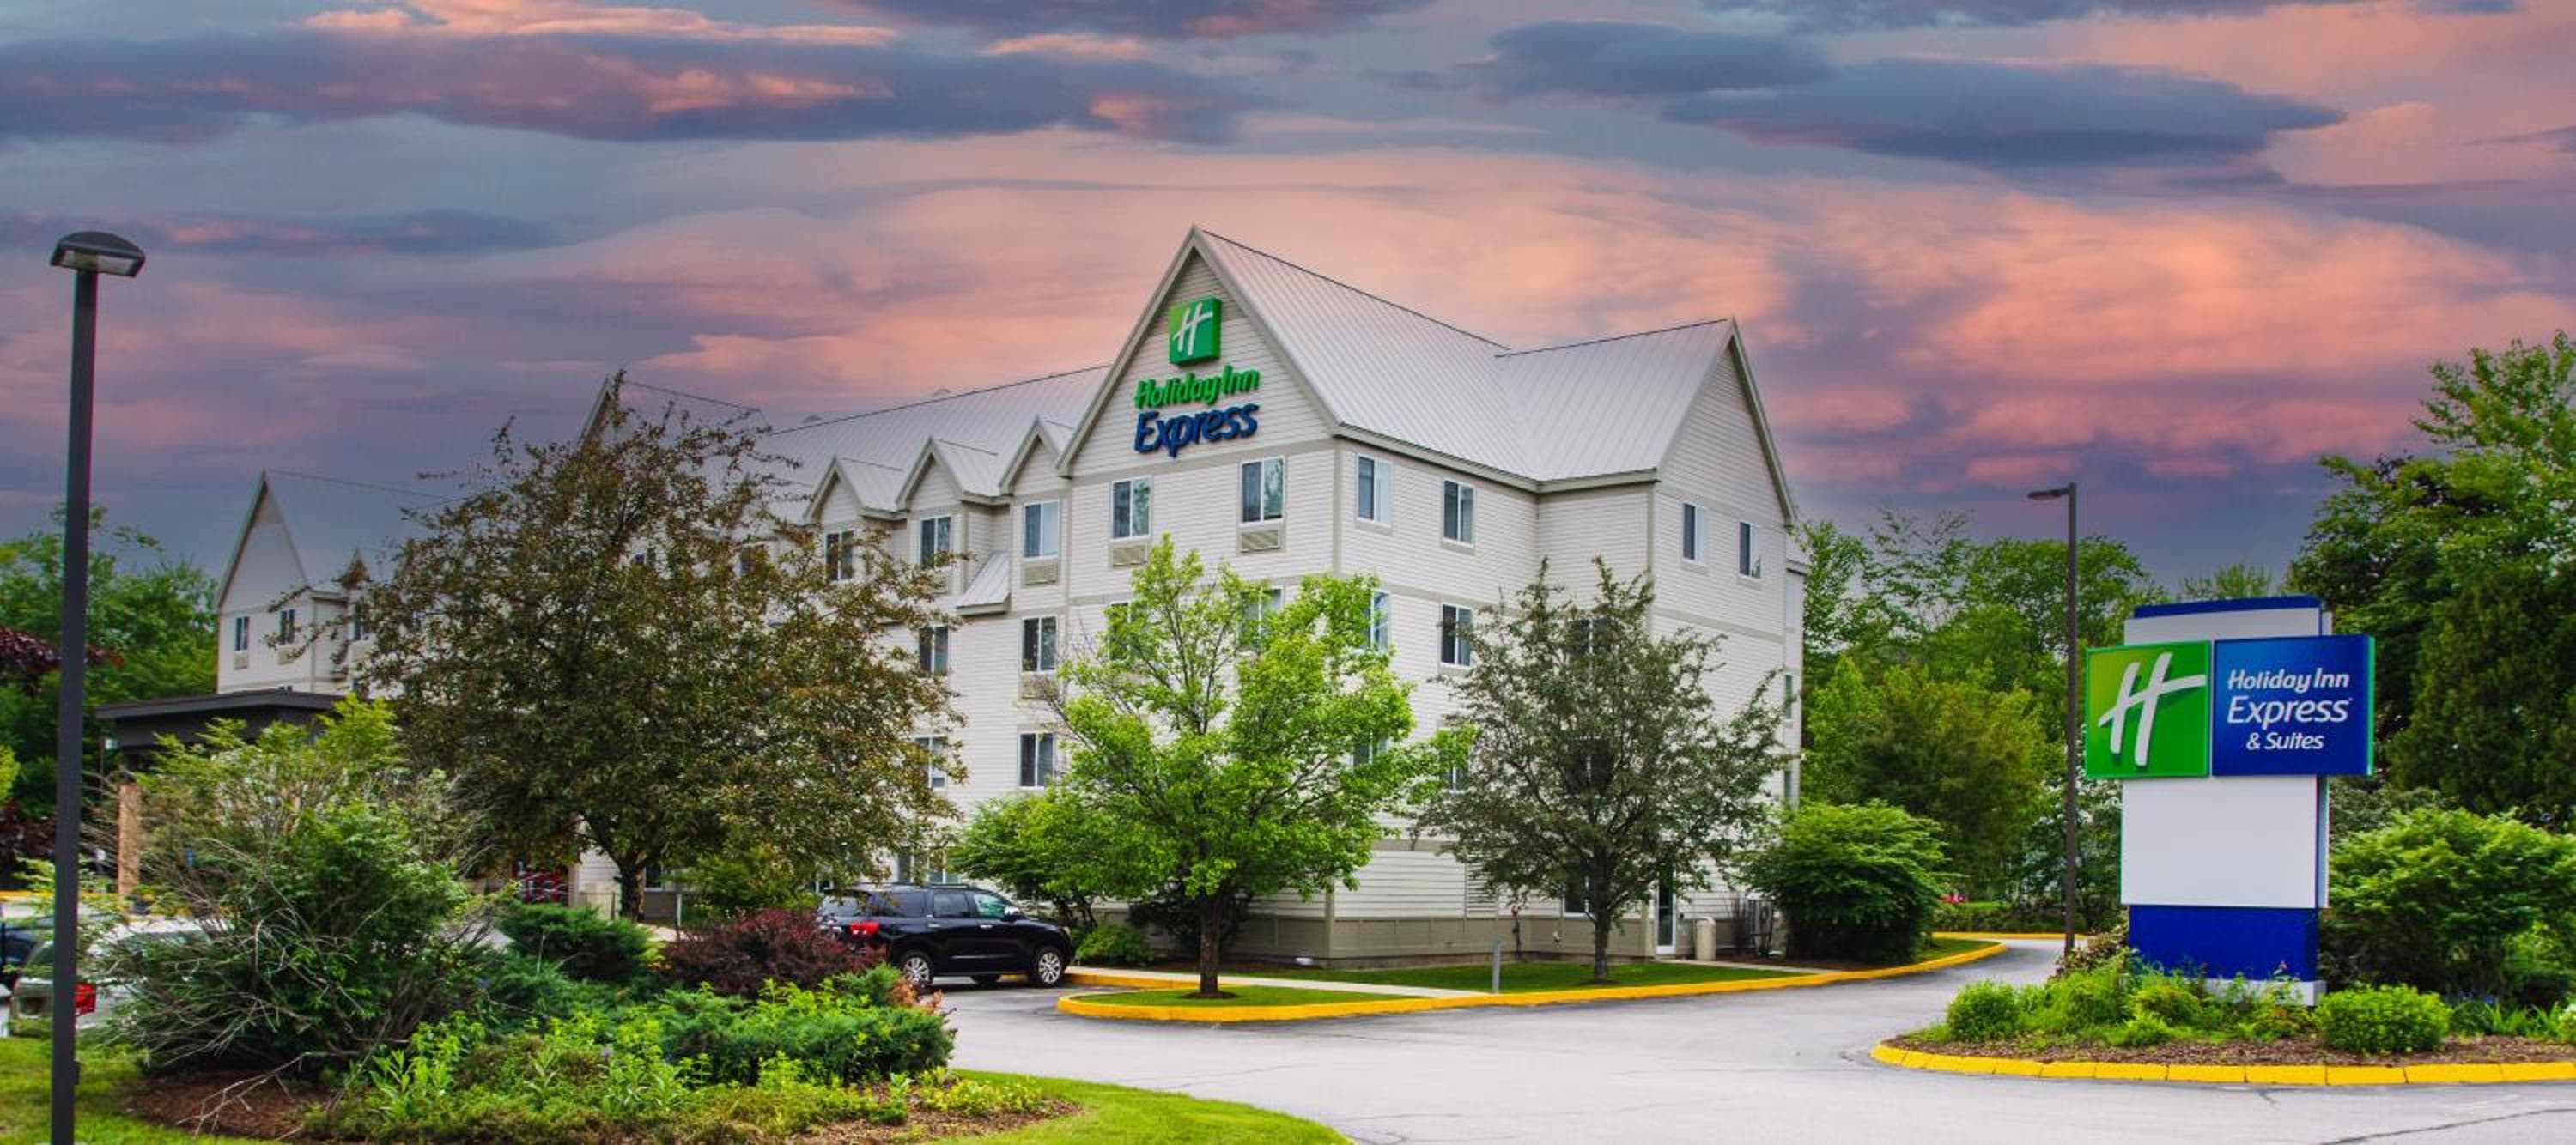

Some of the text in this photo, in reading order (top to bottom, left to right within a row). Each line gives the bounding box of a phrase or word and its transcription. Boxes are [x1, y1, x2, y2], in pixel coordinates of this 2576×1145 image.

[1134, 364, 1260, 409] Holiday Inn
[1134, 403, 1260, 457] Express
[2227, 668, 2350, 693] Holiday Inn
[2246, 732, 2324, 750] & Suites
